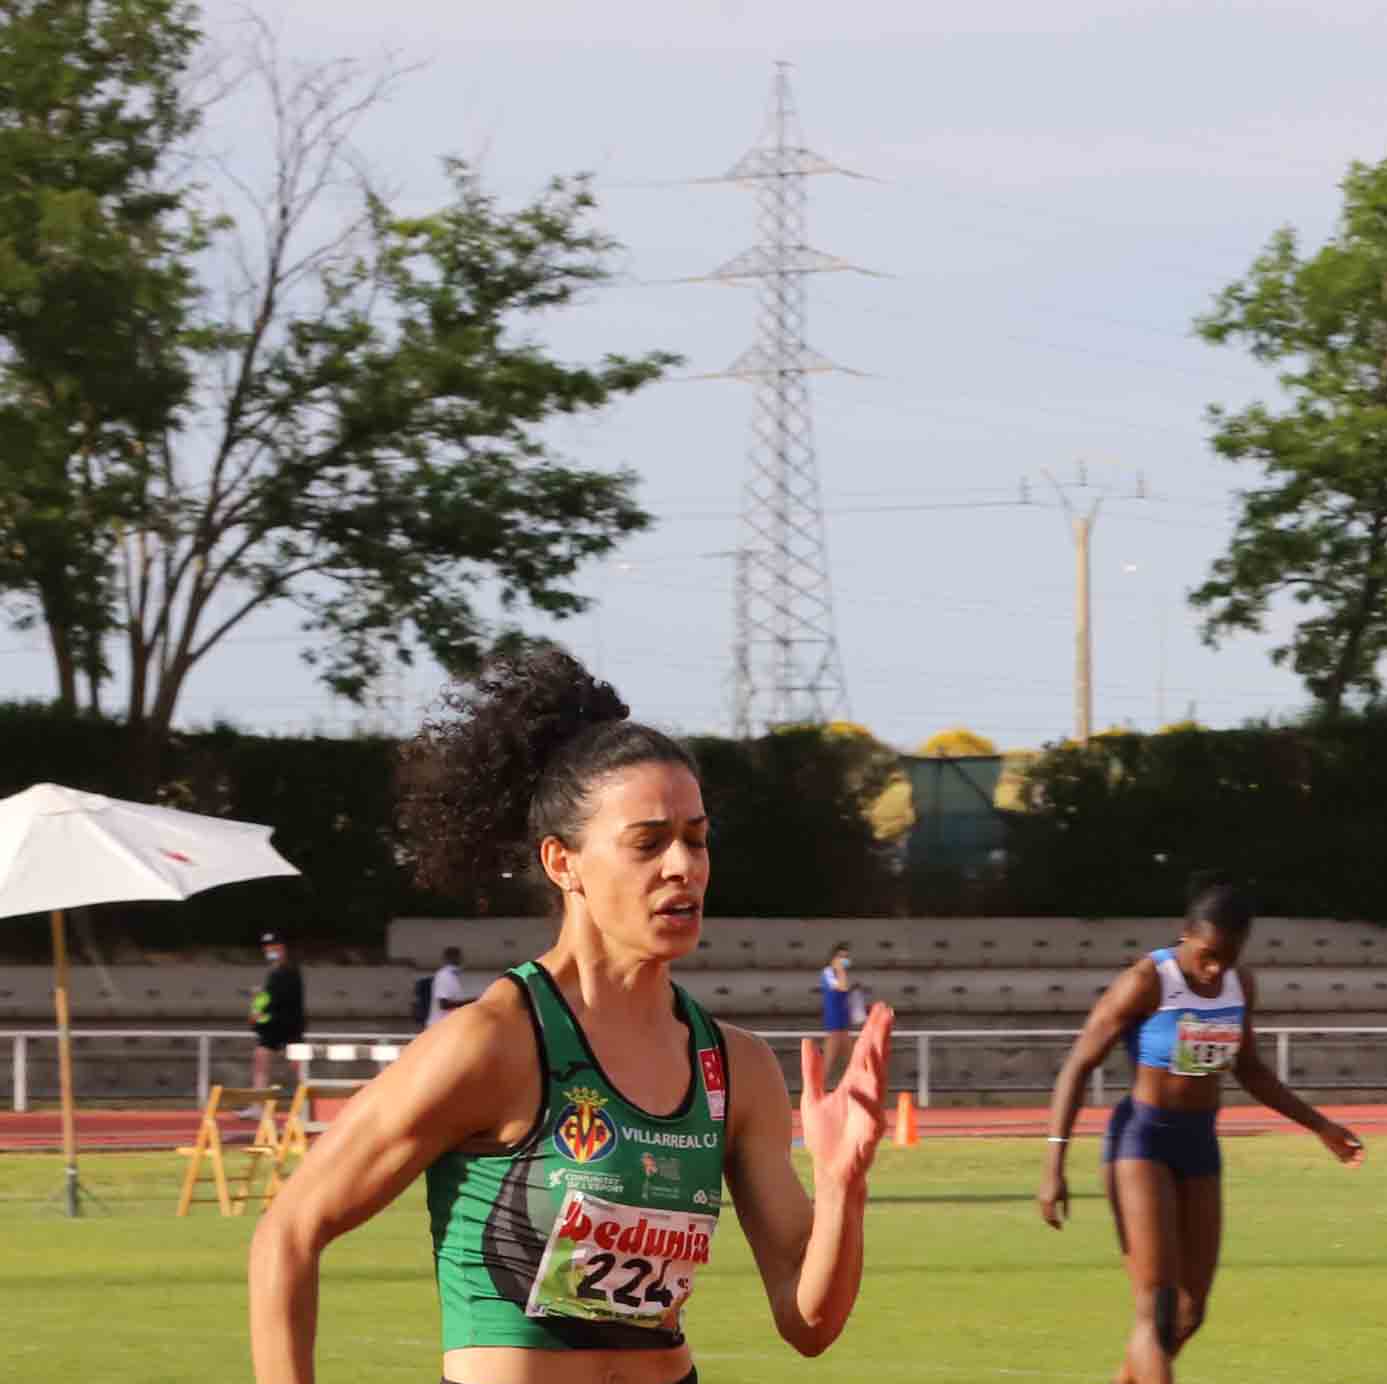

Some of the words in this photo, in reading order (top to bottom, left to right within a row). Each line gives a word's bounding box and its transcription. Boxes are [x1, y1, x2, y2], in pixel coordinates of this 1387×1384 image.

[623, 1127, 702, 1149] VILLARREAL
[559, 1200, 708, 1264] bedunia
[577, 1252, 674, 1308] 224
